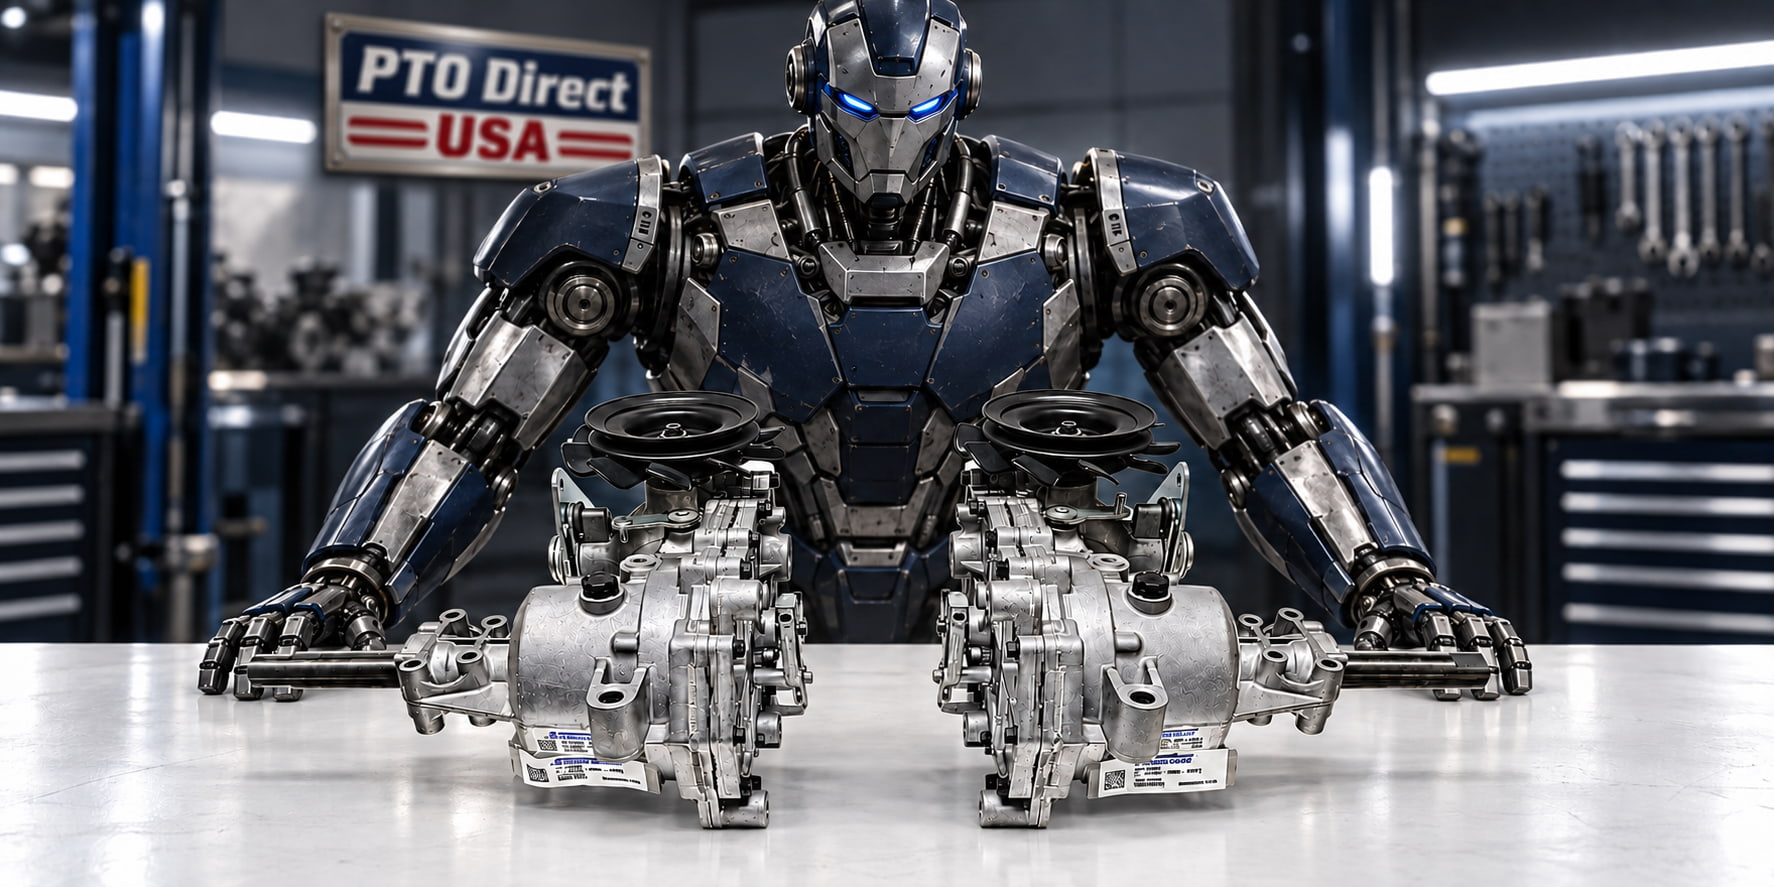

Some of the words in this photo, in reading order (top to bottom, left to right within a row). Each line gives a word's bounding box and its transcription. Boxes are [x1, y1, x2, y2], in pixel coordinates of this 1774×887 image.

[358, 46, 471, 99] PTO
[482, 58, 630, 111] Direct
[436, 114, 549, 161] USA
